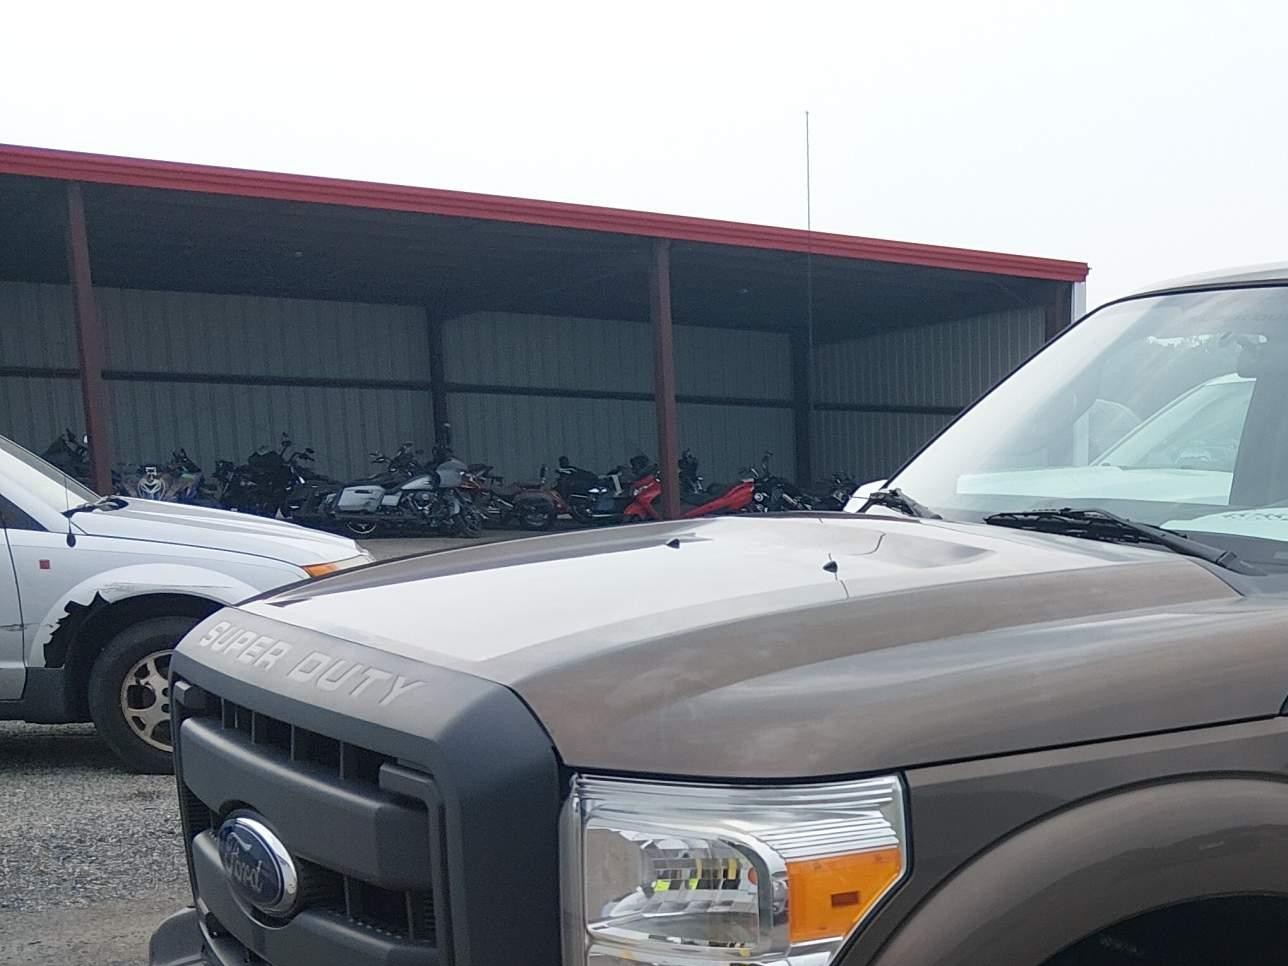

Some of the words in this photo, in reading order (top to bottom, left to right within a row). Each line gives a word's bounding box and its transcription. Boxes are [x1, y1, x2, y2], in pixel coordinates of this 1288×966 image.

[199, 621, 293, 671] SUPER
[285, 650, 427, 707] DUTY
[223, 831, 264, 894] Ford
